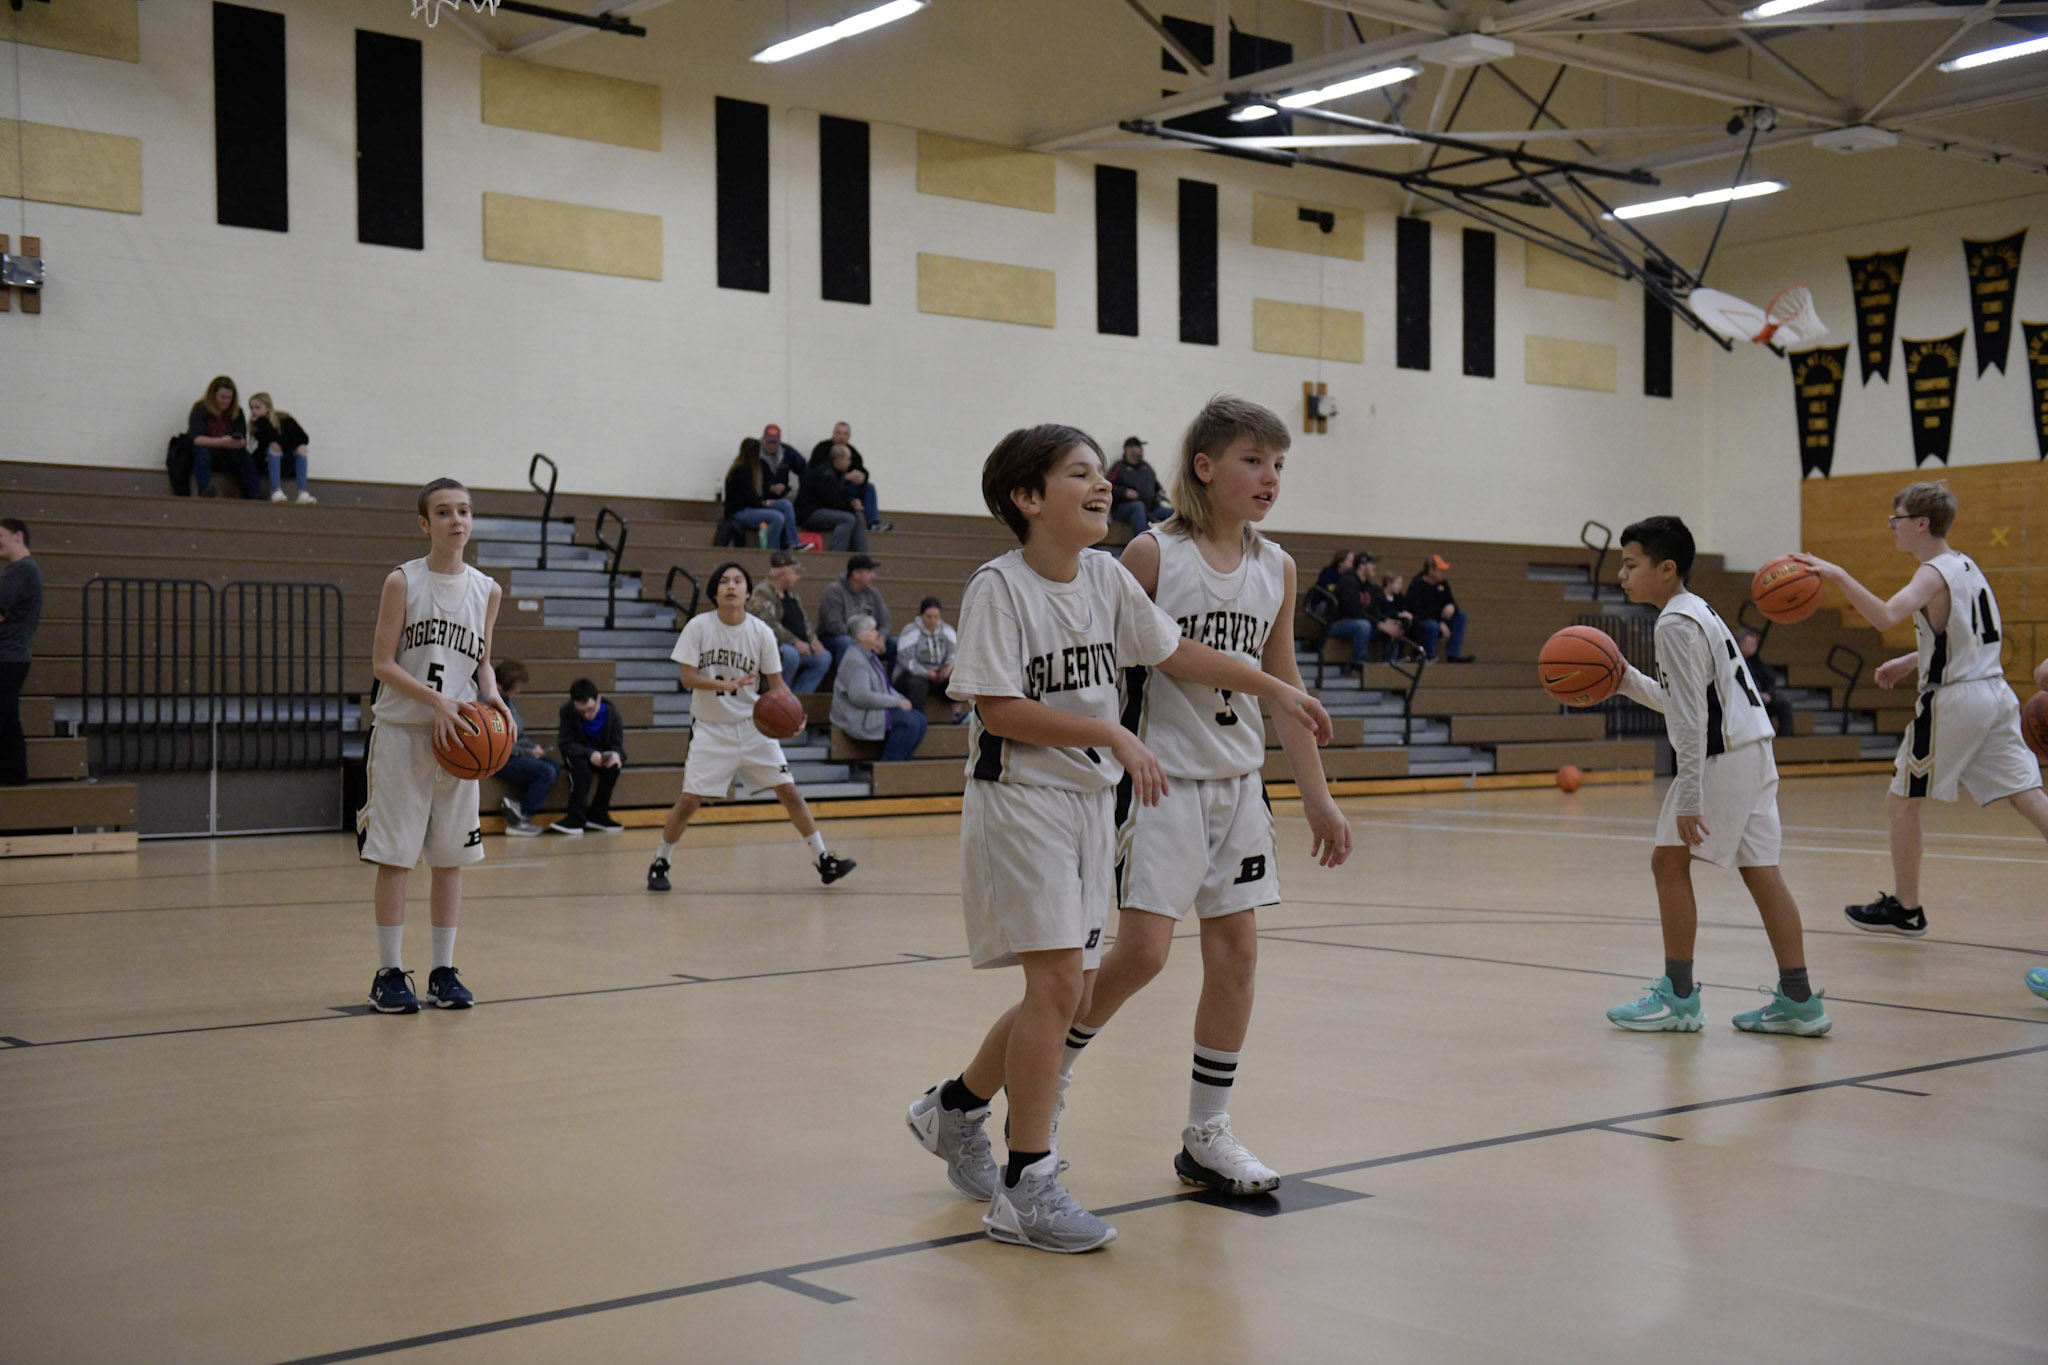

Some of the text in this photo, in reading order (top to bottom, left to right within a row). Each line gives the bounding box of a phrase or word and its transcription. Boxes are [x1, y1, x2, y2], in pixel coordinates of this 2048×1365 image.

[426, 662, 445, 693] 5
[463, 828, 482, 848] B
[1233, 853, 1266, 885] B
[1085, 928, 1102, 950] B
